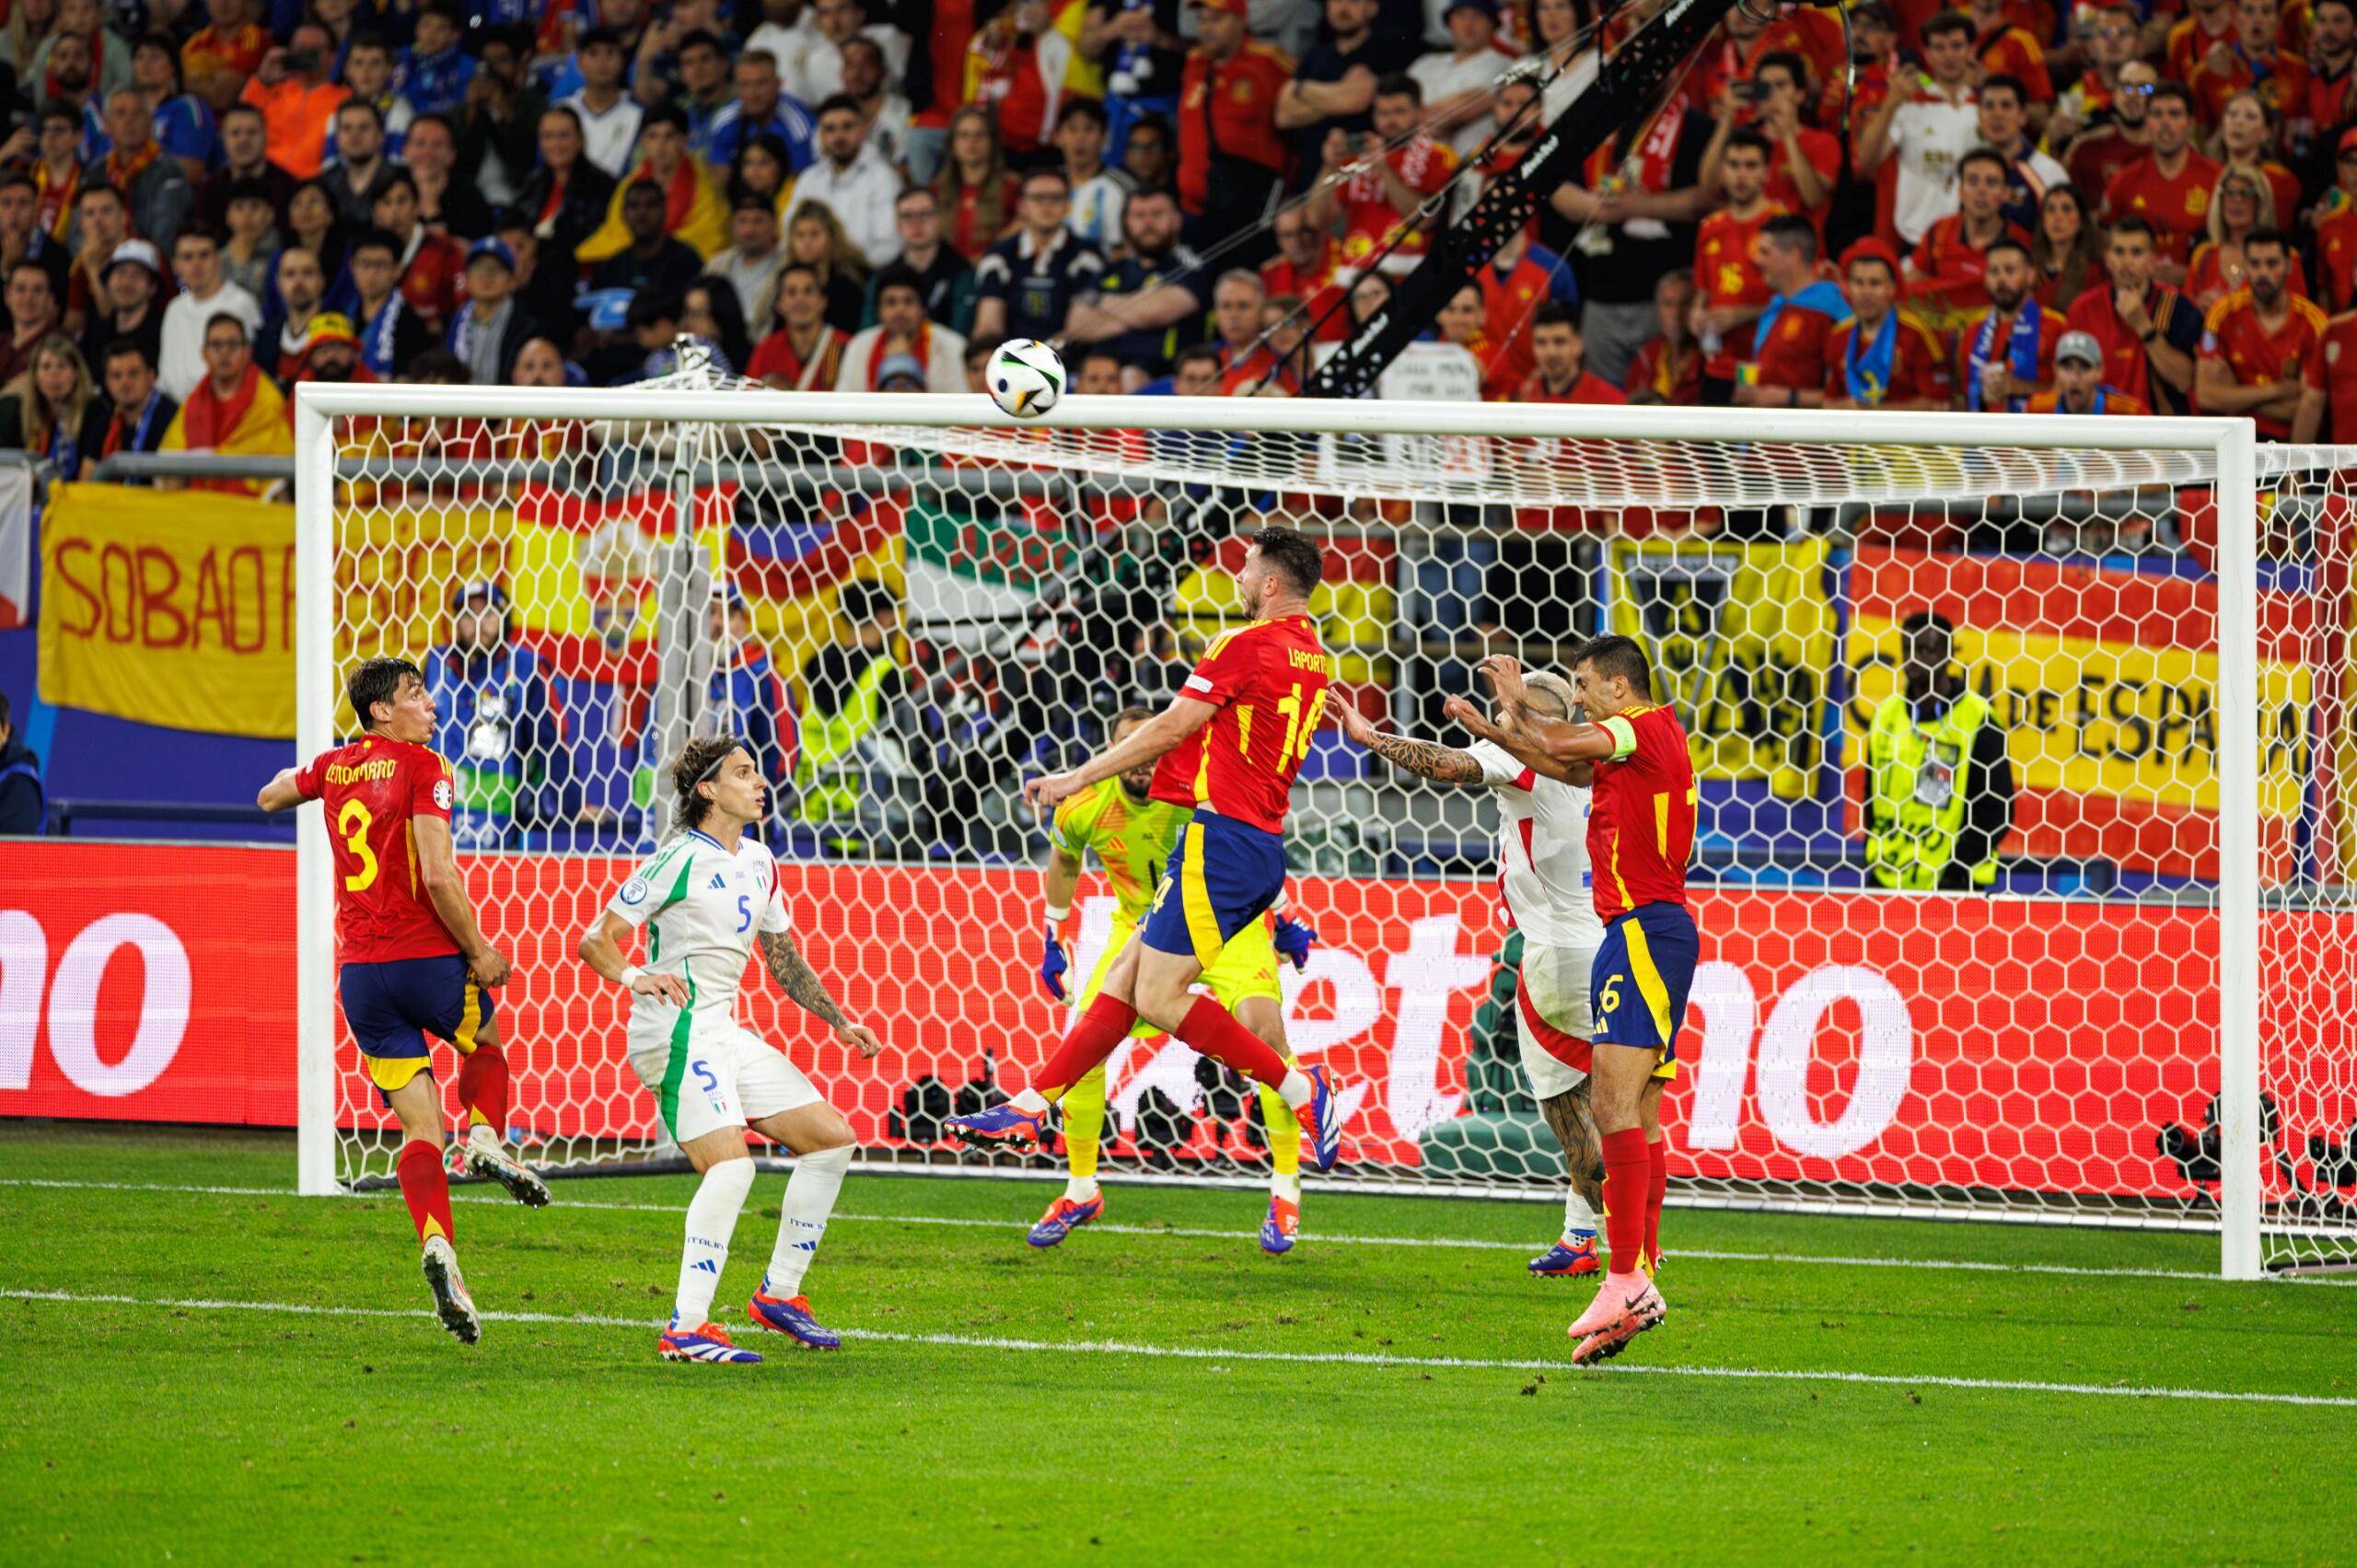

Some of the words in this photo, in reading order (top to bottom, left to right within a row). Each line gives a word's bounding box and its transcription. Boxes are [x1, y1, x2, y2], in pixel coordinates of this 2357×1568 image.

[55, 537, 266, 654] SOBAO
[1288, 646, 1328, 674] LAPORT
[2074, 672, 2303, 781] ESPAA
[338, 798, 378, 892] 3
[737, 894, 752, 934] 5
[691, 1060, 717, 1092] 5
